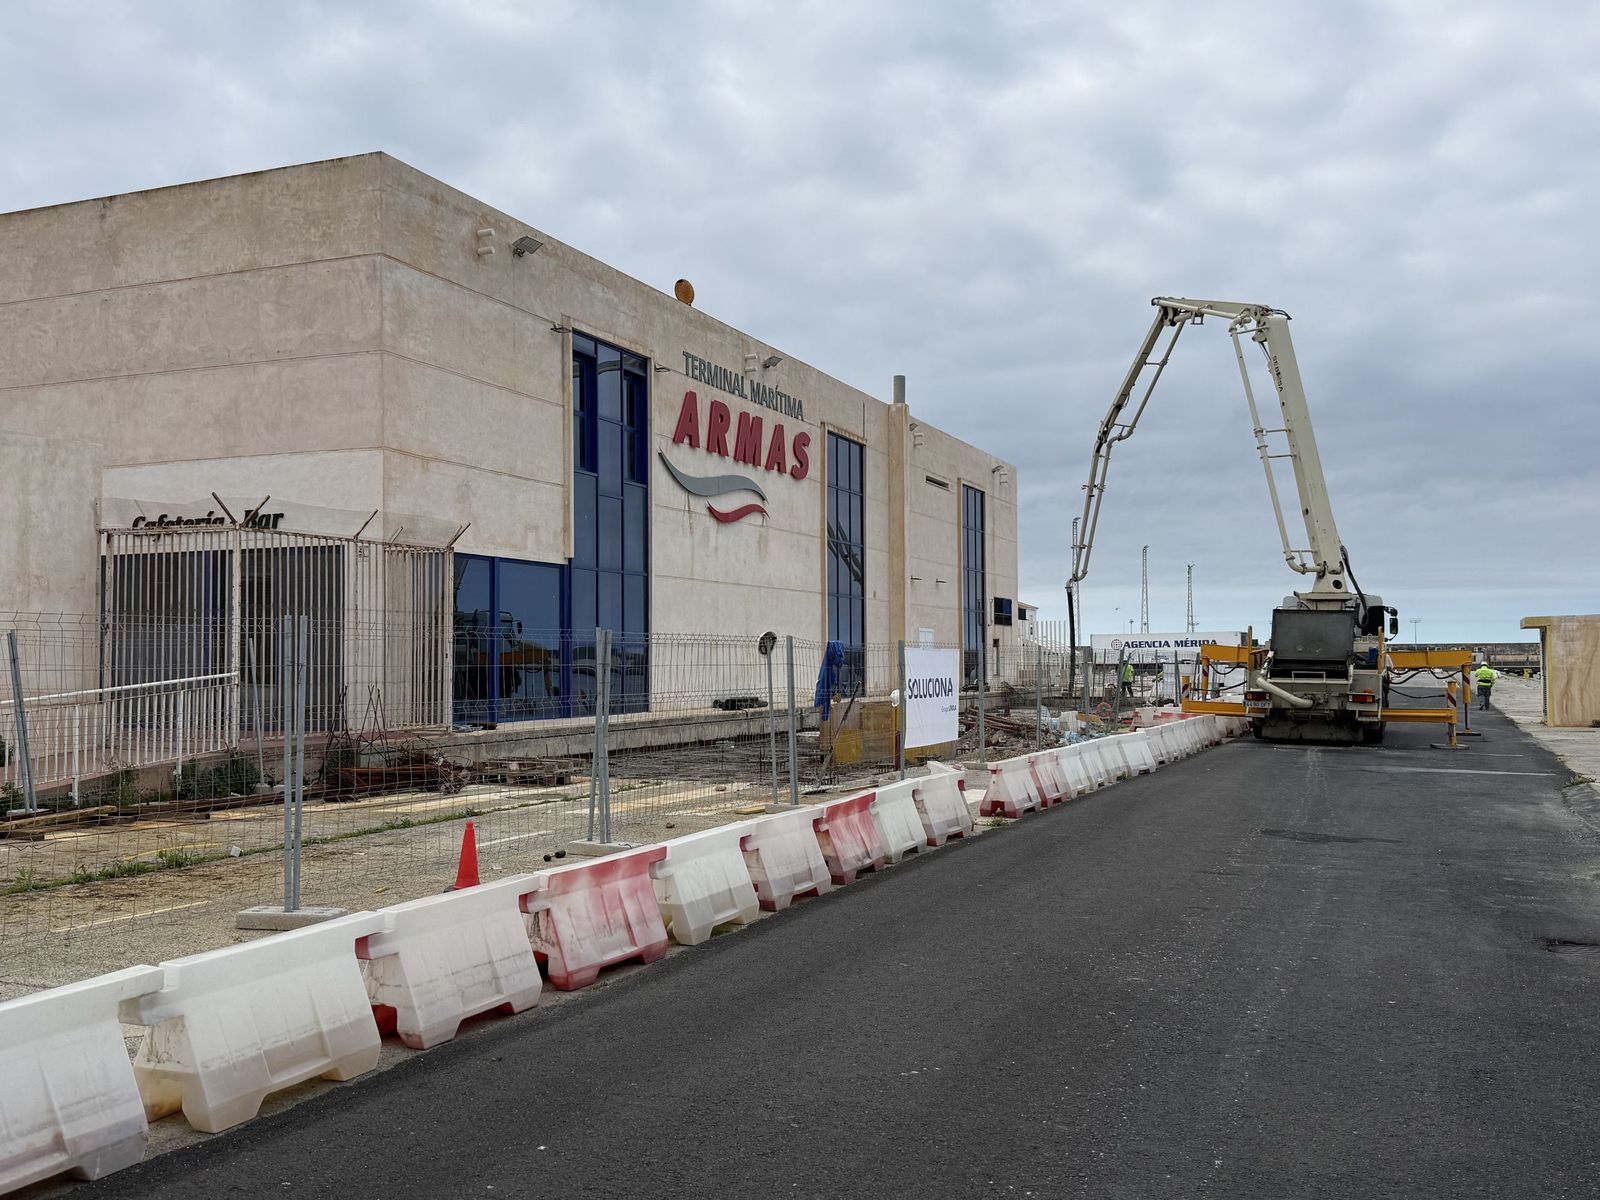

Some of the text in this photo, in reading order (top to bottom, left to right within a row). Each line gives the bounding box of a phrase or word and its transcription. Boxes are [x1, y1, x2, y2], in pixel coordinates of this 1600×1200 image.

[682, 350, 804, 422] TERMINAL MARÍTIMA
[672, 390, 811, 481] ARMAS
[243, 509, 285, 530] Bar
[1123, 640, 1170, 649] AGENCIA
[908, 677, 953, 700] SOLUCIONA
